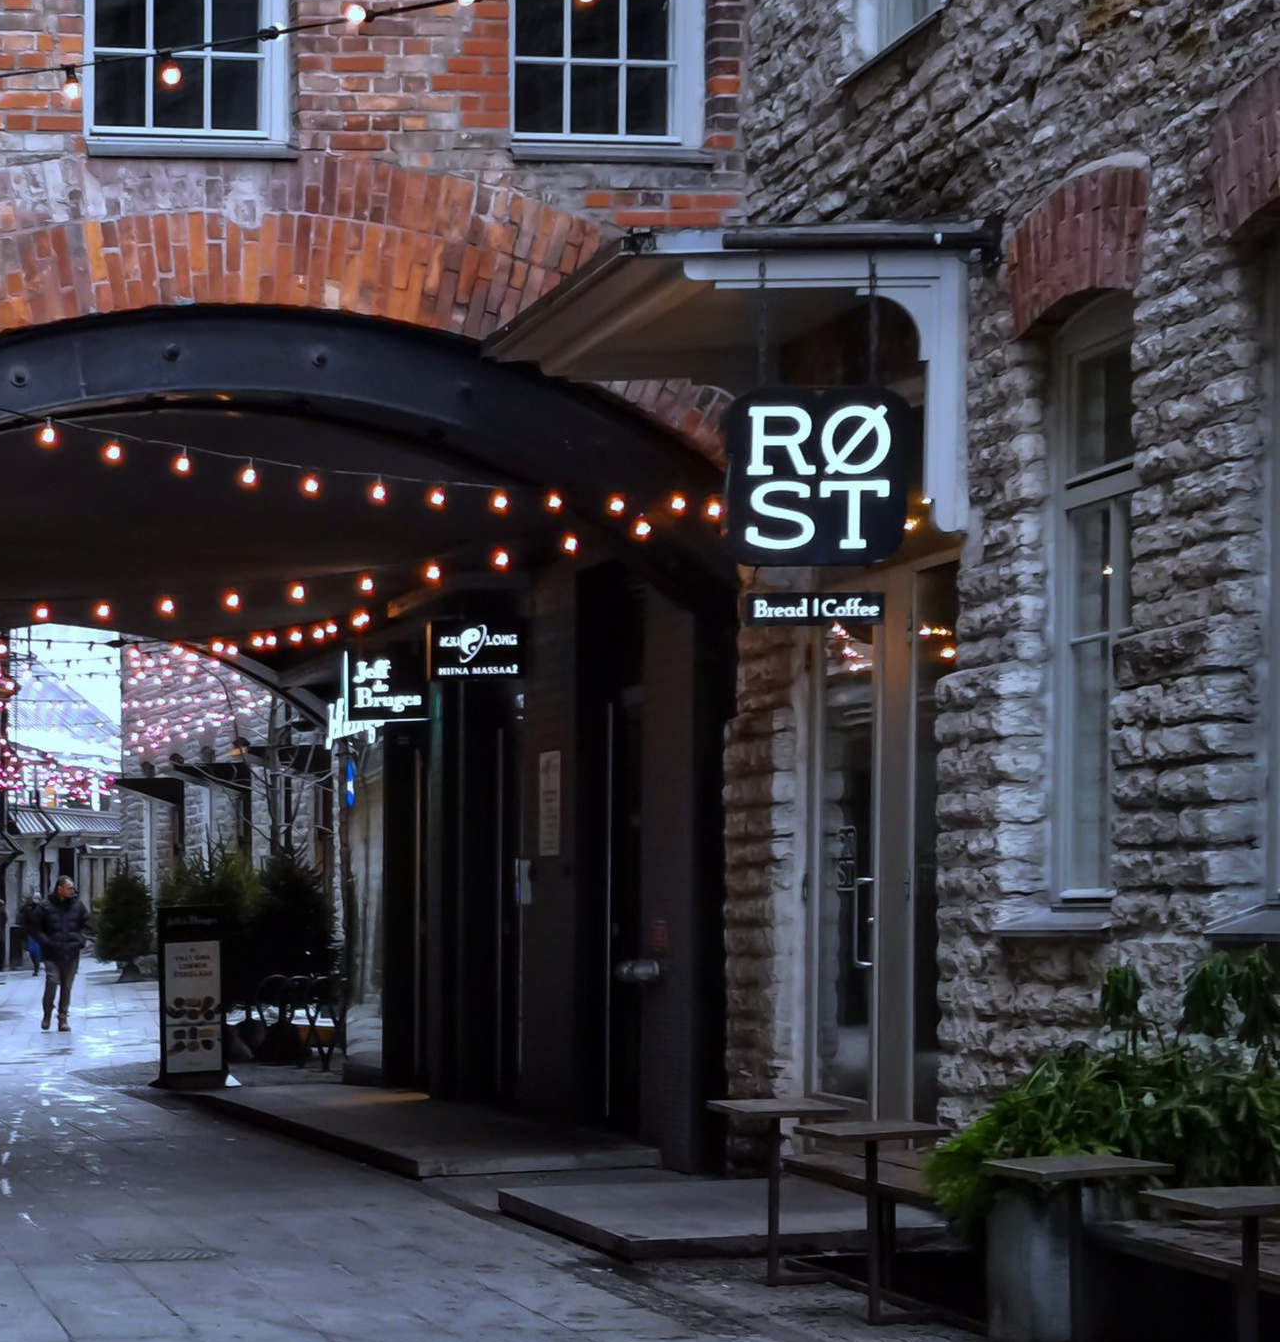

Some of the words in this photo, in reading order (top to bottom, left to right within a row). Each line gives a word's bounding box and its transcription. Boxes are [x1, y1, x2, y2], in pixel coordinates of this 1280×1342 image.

[746, 404, 892, 476] RØ
[744, 479, 891, 550] ST
[753, 597, 808, 618] Bread
[821, 597, 880, 618] Coffee
[352, 658, 392, 683] Jeff
[372, 679, 389, 693] de
[352, 686, 422, 713] Bruges
